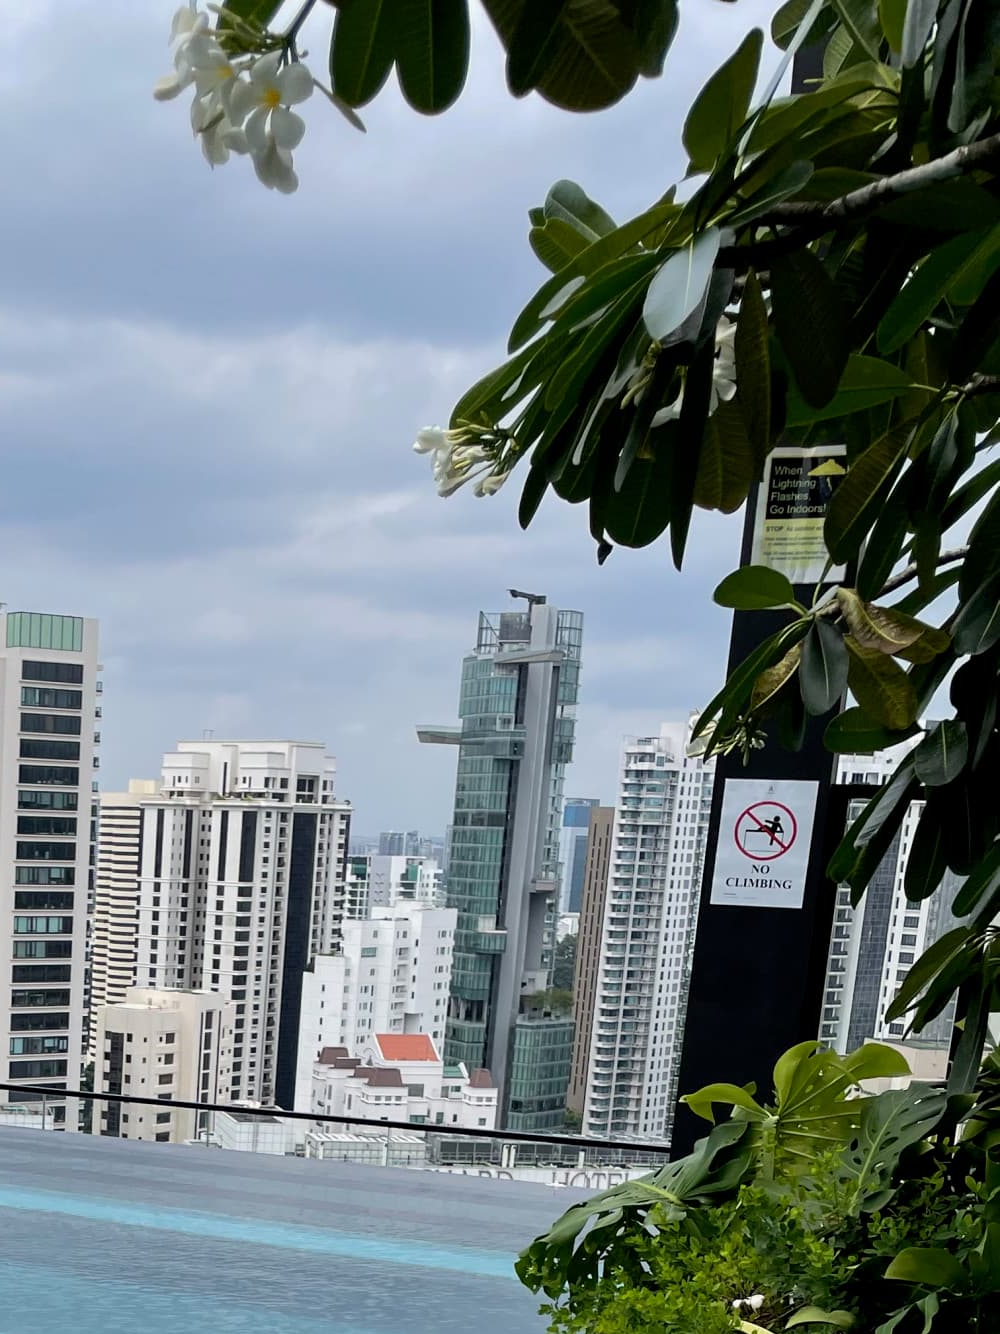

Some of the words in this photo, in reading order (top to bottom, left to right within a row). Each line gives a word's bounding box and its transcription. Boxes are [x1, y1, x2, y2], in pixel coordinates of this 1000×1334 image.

[775, 466, 802, 475] When
[772, 480, 816, 490] Lightning
[770, 505, 784, 513] Go
[787, 504, 826, 513] Indoors!
[751, 864, 770, 874] NO
[726, 877, 792, 889] CLIMBING
